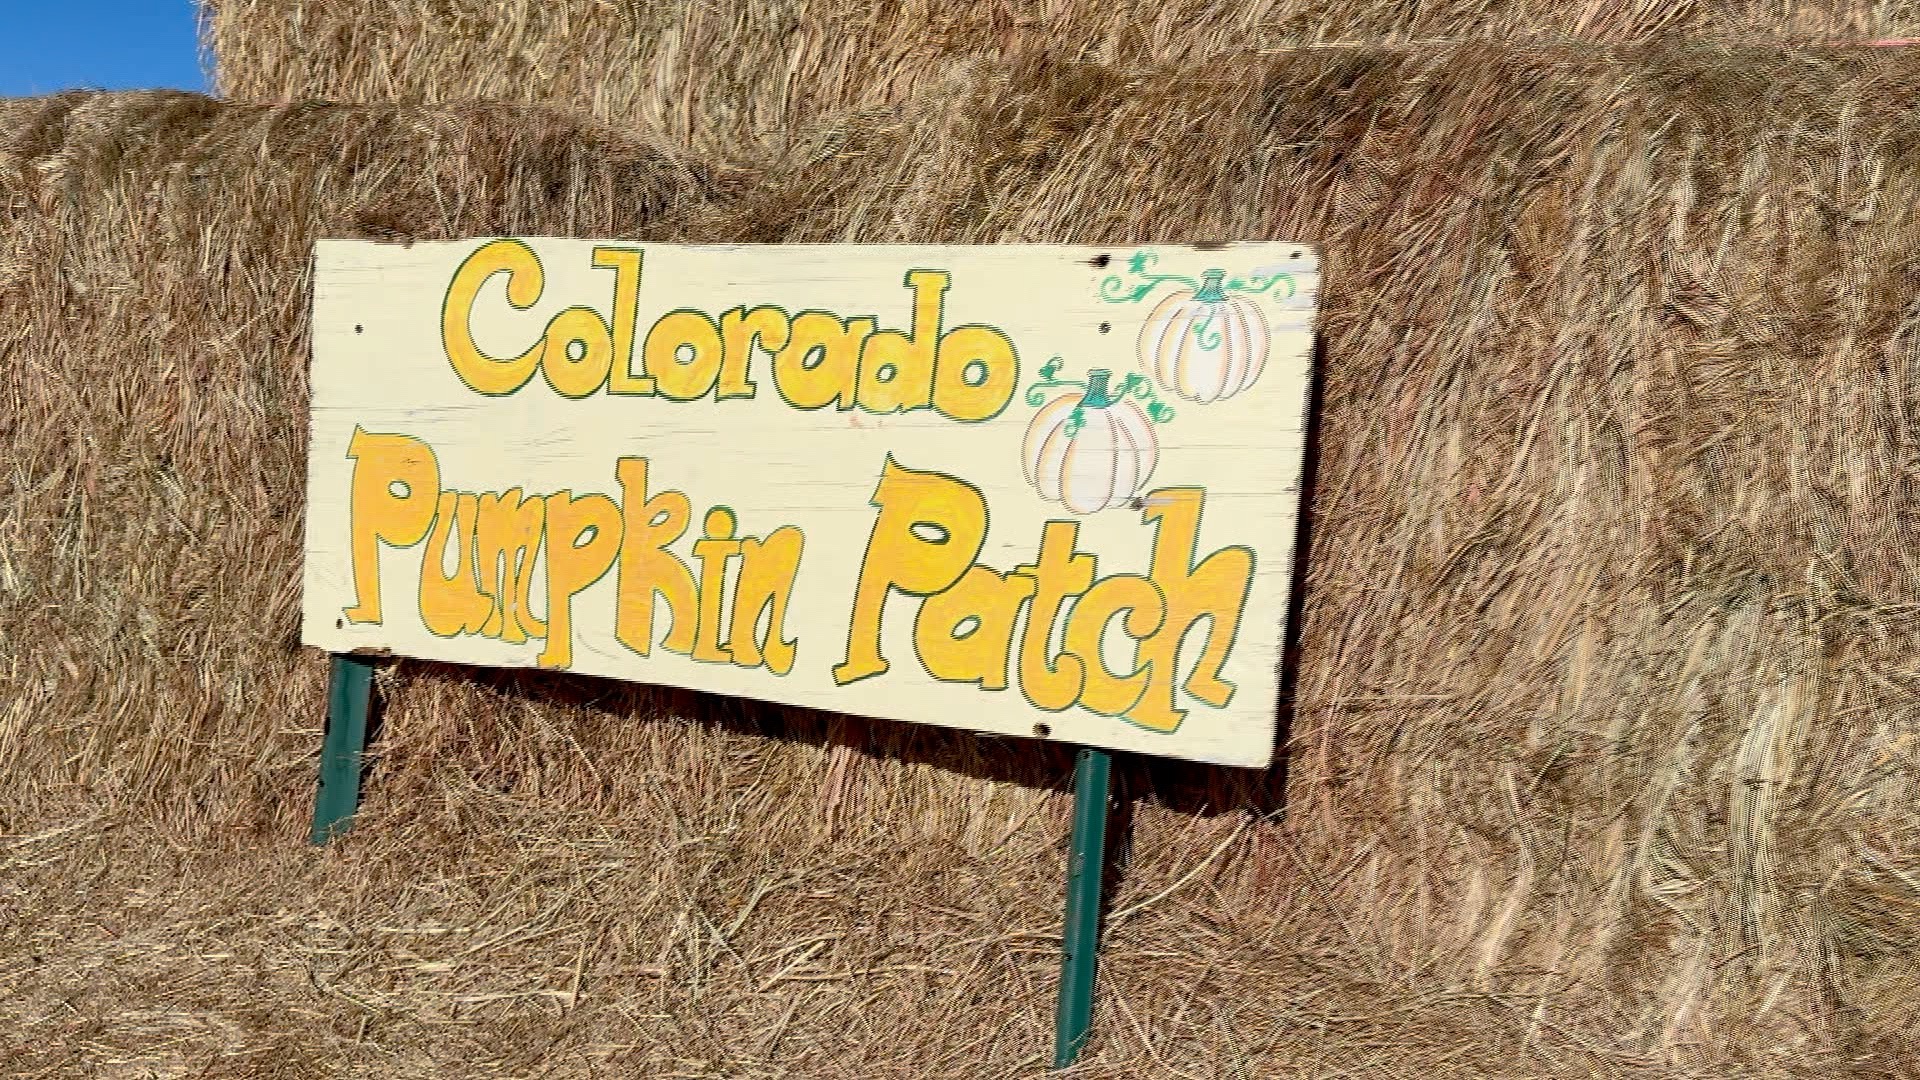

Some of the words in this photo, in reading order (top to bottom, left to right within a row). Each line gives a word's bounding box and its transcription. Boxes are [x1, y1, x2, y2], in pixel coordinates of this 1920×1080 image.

[440, 239, 1020, 421] Colorado
[342, 424, 806, 675] Pumpkin
[833, 452, 1256, 733] Patch
